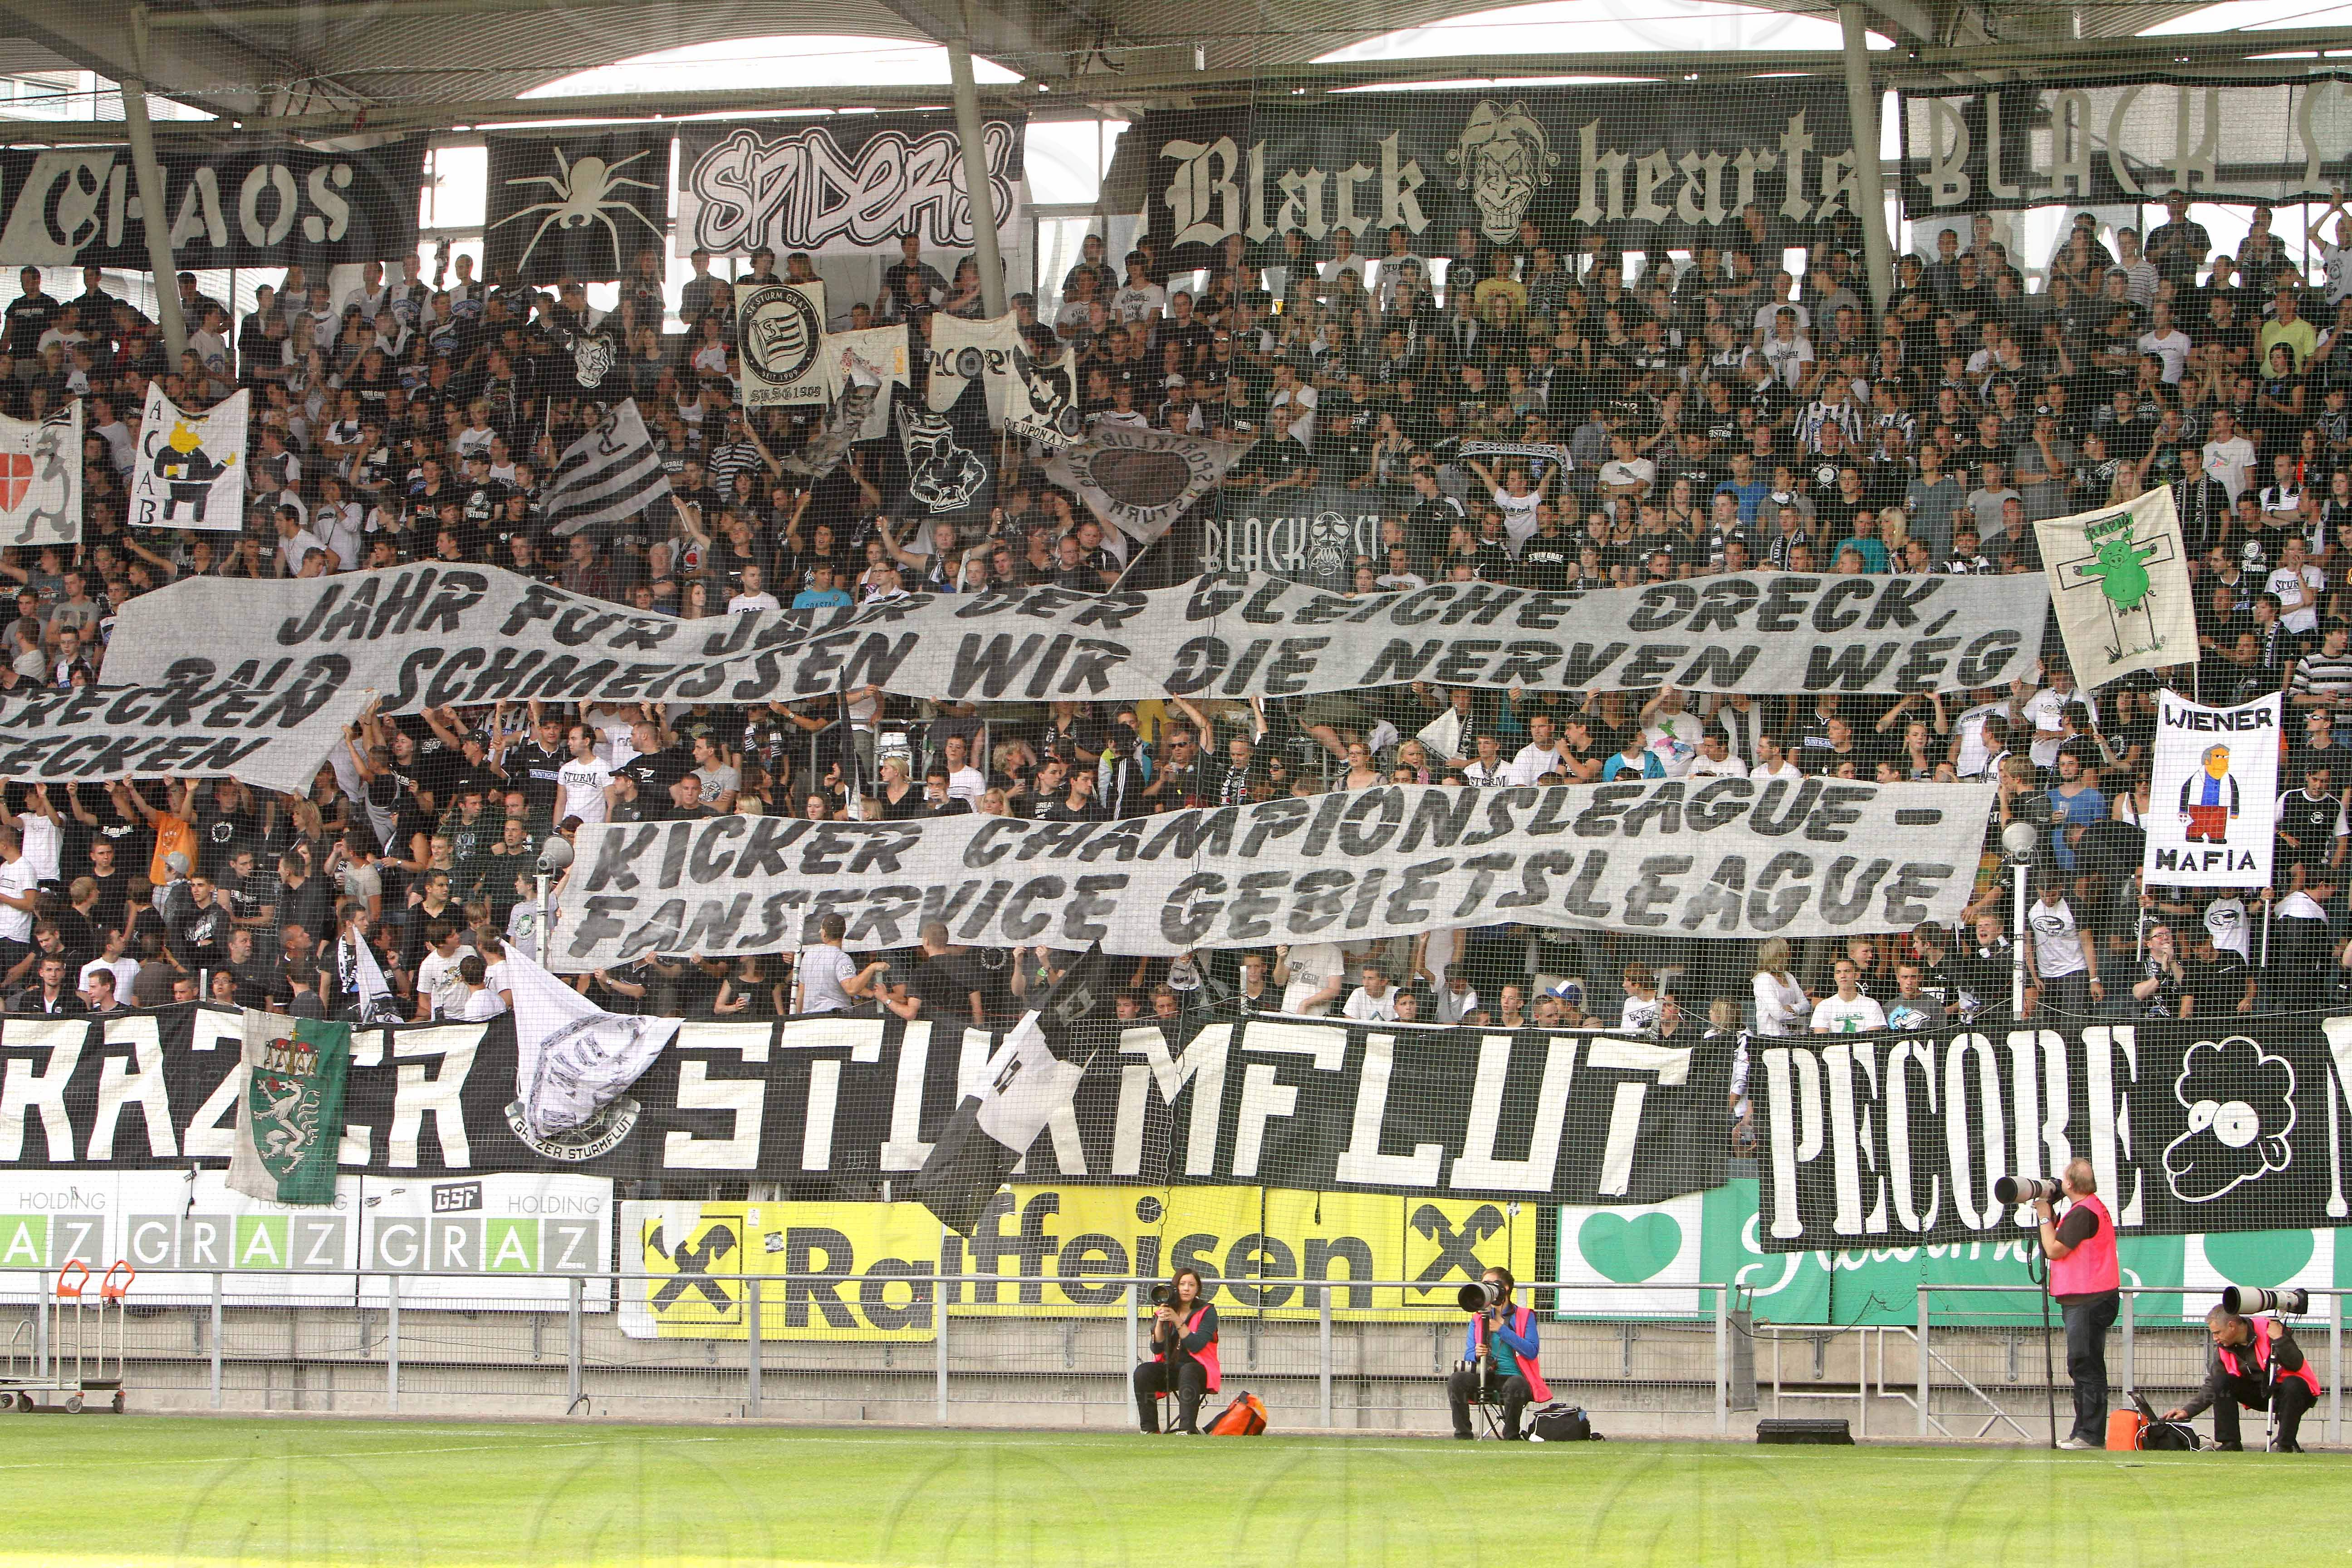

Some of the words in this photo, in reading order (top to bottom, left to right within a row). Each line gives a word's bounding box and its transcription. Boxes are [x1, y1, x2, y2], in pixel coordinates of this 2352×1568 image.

[1160, 130, 1431, 249] Black
[1571, 106, 1863, 226] hearts
[44, 163, 353, 248] CHAOS
[756, 291, 782, 305] STURM
[786, 294, 808, 313] GRAZ
[762, 371, 776, 380] SEIT
[1021, 423, 1048, 440] UPON
[1049, 433, 1056, 444] A
[278, 568, 488, 646] JAHR
[956, 587, 1149, 631] DER
[1186, 571, 1586, 631] GLEICHE
[378, 632, 920, 715] SCHMEISSEN
[948, 632, 1132, 699] WIR
[1164, 635, 1331, 696] DIE
[1357, 637, 1761, 690] NERVEN
[1803, 629, 2023, 694] WEG
[2165, 703, 2273, 731] WIENER
[583, 814, 924, 892] KICKER
[962, 777, 1877, 862] CHAMPIONSLEAGUE
[2155, 848, 2257, 872] MAFIA
[568, 873, 1131, 959] FANSERVICE
[1160, 849, 1955, 945] GEBIETSLEAGUE
[514, 1120, 563, 1158] GRZER
[568, 1115, 632, 1160] STURMFLUT
[1762, 1025, 2144, 1239] PECORE
[20, 1191, 106, 1210] HOLDING
[435, 1187, 479, 1210] GSF
[509, 1195, 600, 1214] HOLDING
[133, 1220, 335, 1265] GRAZ
[380, 1223, 589, 1269] GRAZ
[785, 1192, 1373, 1330] Raiffeisen
